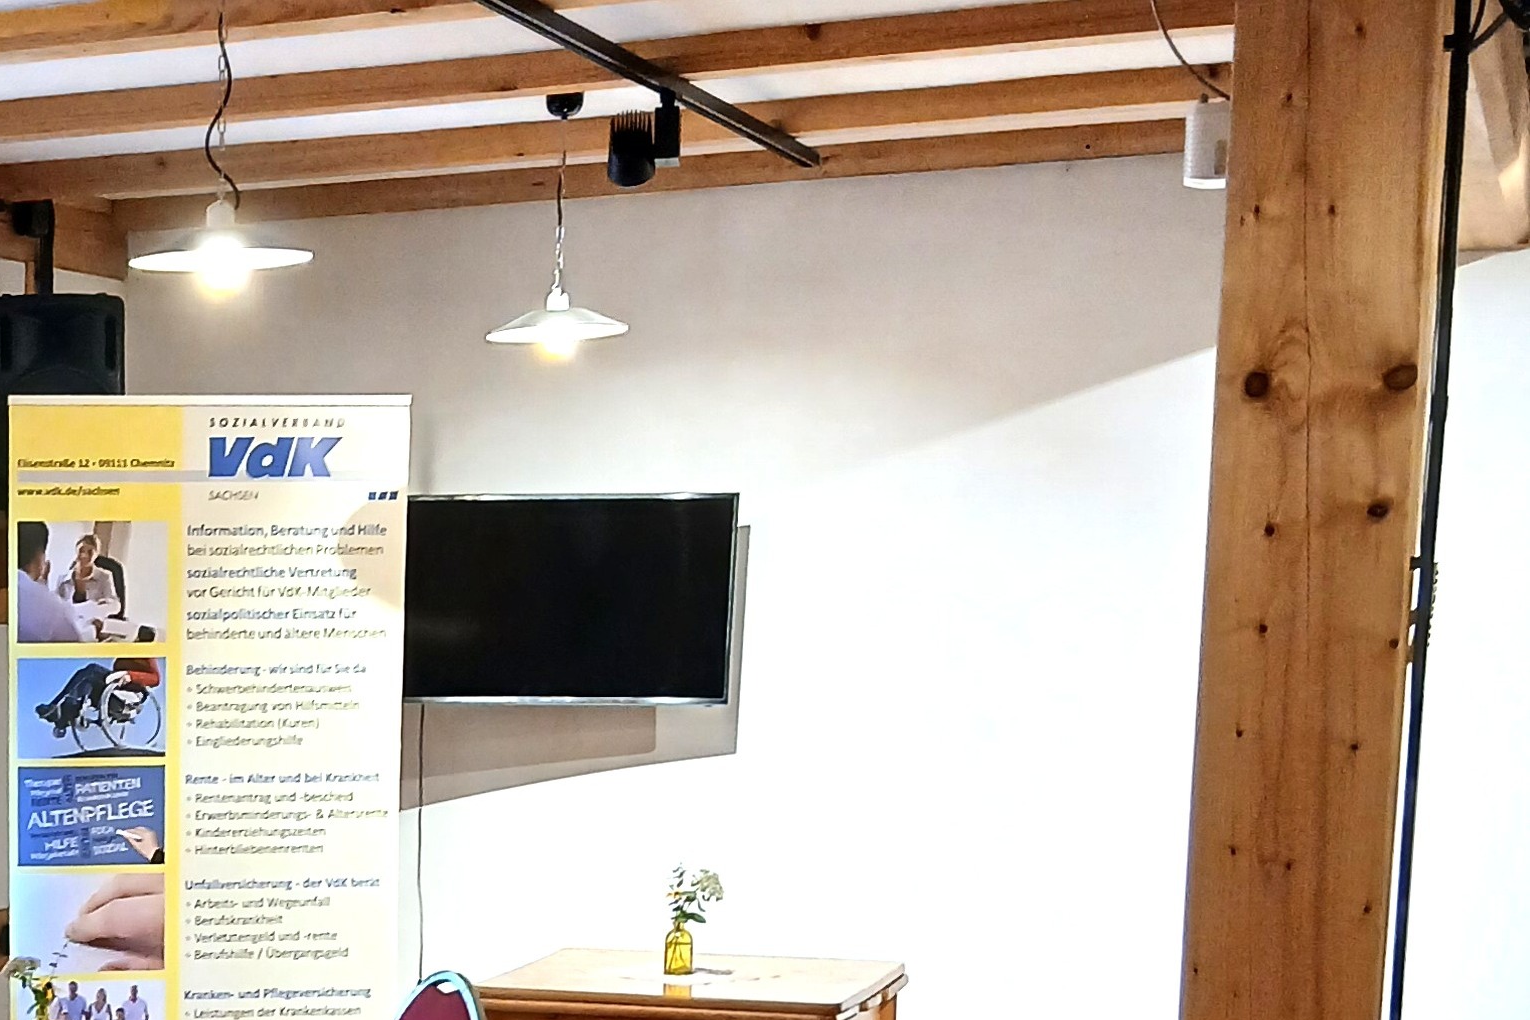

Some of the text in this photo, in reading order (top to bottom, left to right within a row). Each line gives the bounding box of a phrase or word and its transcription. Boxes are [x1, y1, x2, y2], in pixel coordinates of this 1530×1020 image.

[209, 417, 345, 428] SOZIALVERBAND
[208, 436, 343, 478] VdK
[208, 490, 259, 500] SACHSEN
[187, 524, 387, 539] Information, Beratung und Hilfe
[187, 544, 384, 556] bei sozialrechtlichen Problemen
[187, 567, 358, 580] sozialrechtliche Vertretung
[187, 588, 207, 598] vor
[209, 587, 255, 598] Gericht
[257, 586, 276, 598] für
[187, 609, 357, 622] sozialpolitischer Einsatz für
[187, 628, 256, 640] behinderte
[258, 628, 282, 639] und
[185, 774, 219, 784] Rente
[247, 773, 275, 783] Alter
[279, 773, 301, 783] und
[304, 773, 322, 783] bei
[274, 793, 296, 802] und
[27, 800, 155, 830] ALTENPFLEGE
[303, 879, 322, 887] der
[325, 879, 347, 887] VdK
[241, 898, 263, 908] und
[278, 931, 300, 941] und
[238, 989, 260, 999] und
[257, 1008, 276, 1017] der
